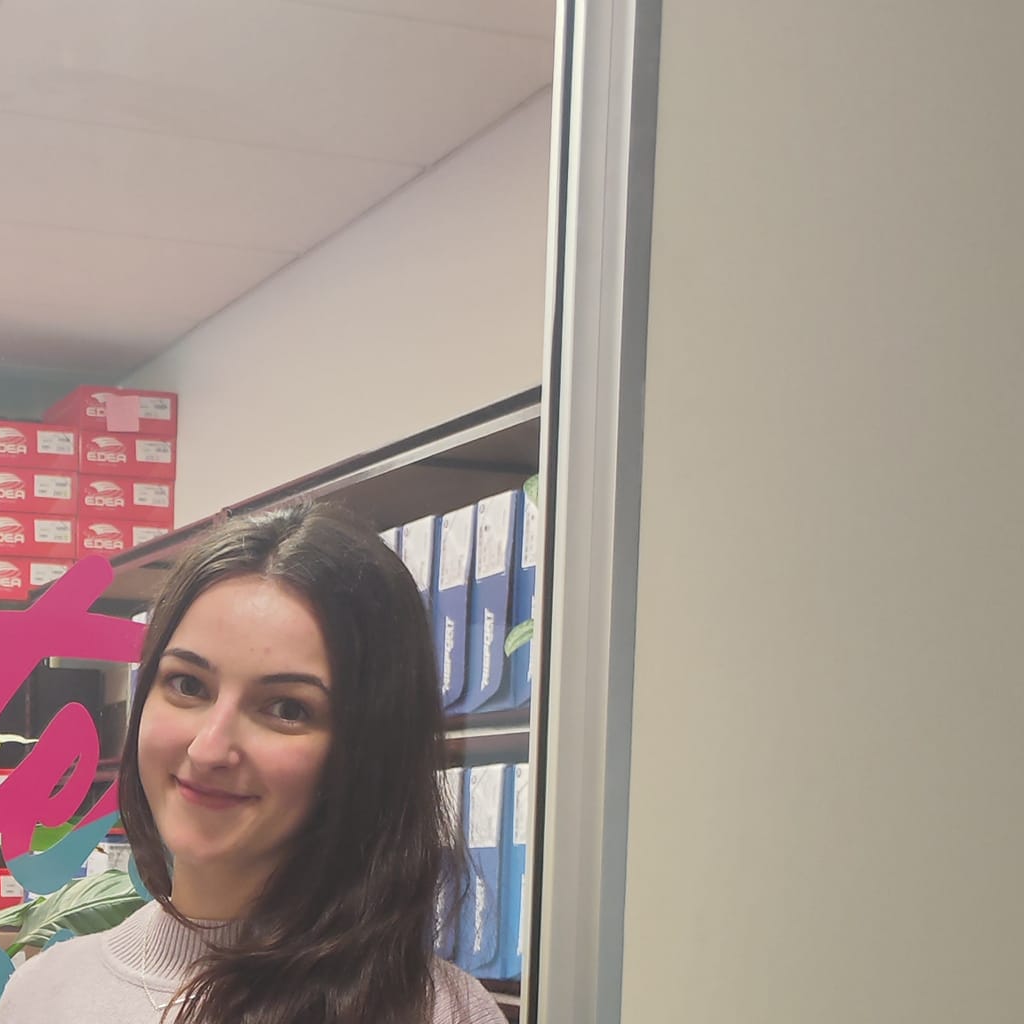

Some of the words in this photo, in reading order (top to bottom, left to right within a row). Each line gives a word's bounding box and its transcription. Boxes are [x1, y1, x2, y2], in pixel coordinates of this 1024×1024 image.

[86, 407, 105, 417] ED
[87, 452, 127, 463] EDEA
[85, 497, 125, 508] EDEA
[84, 540, 124, 550] EDEA
